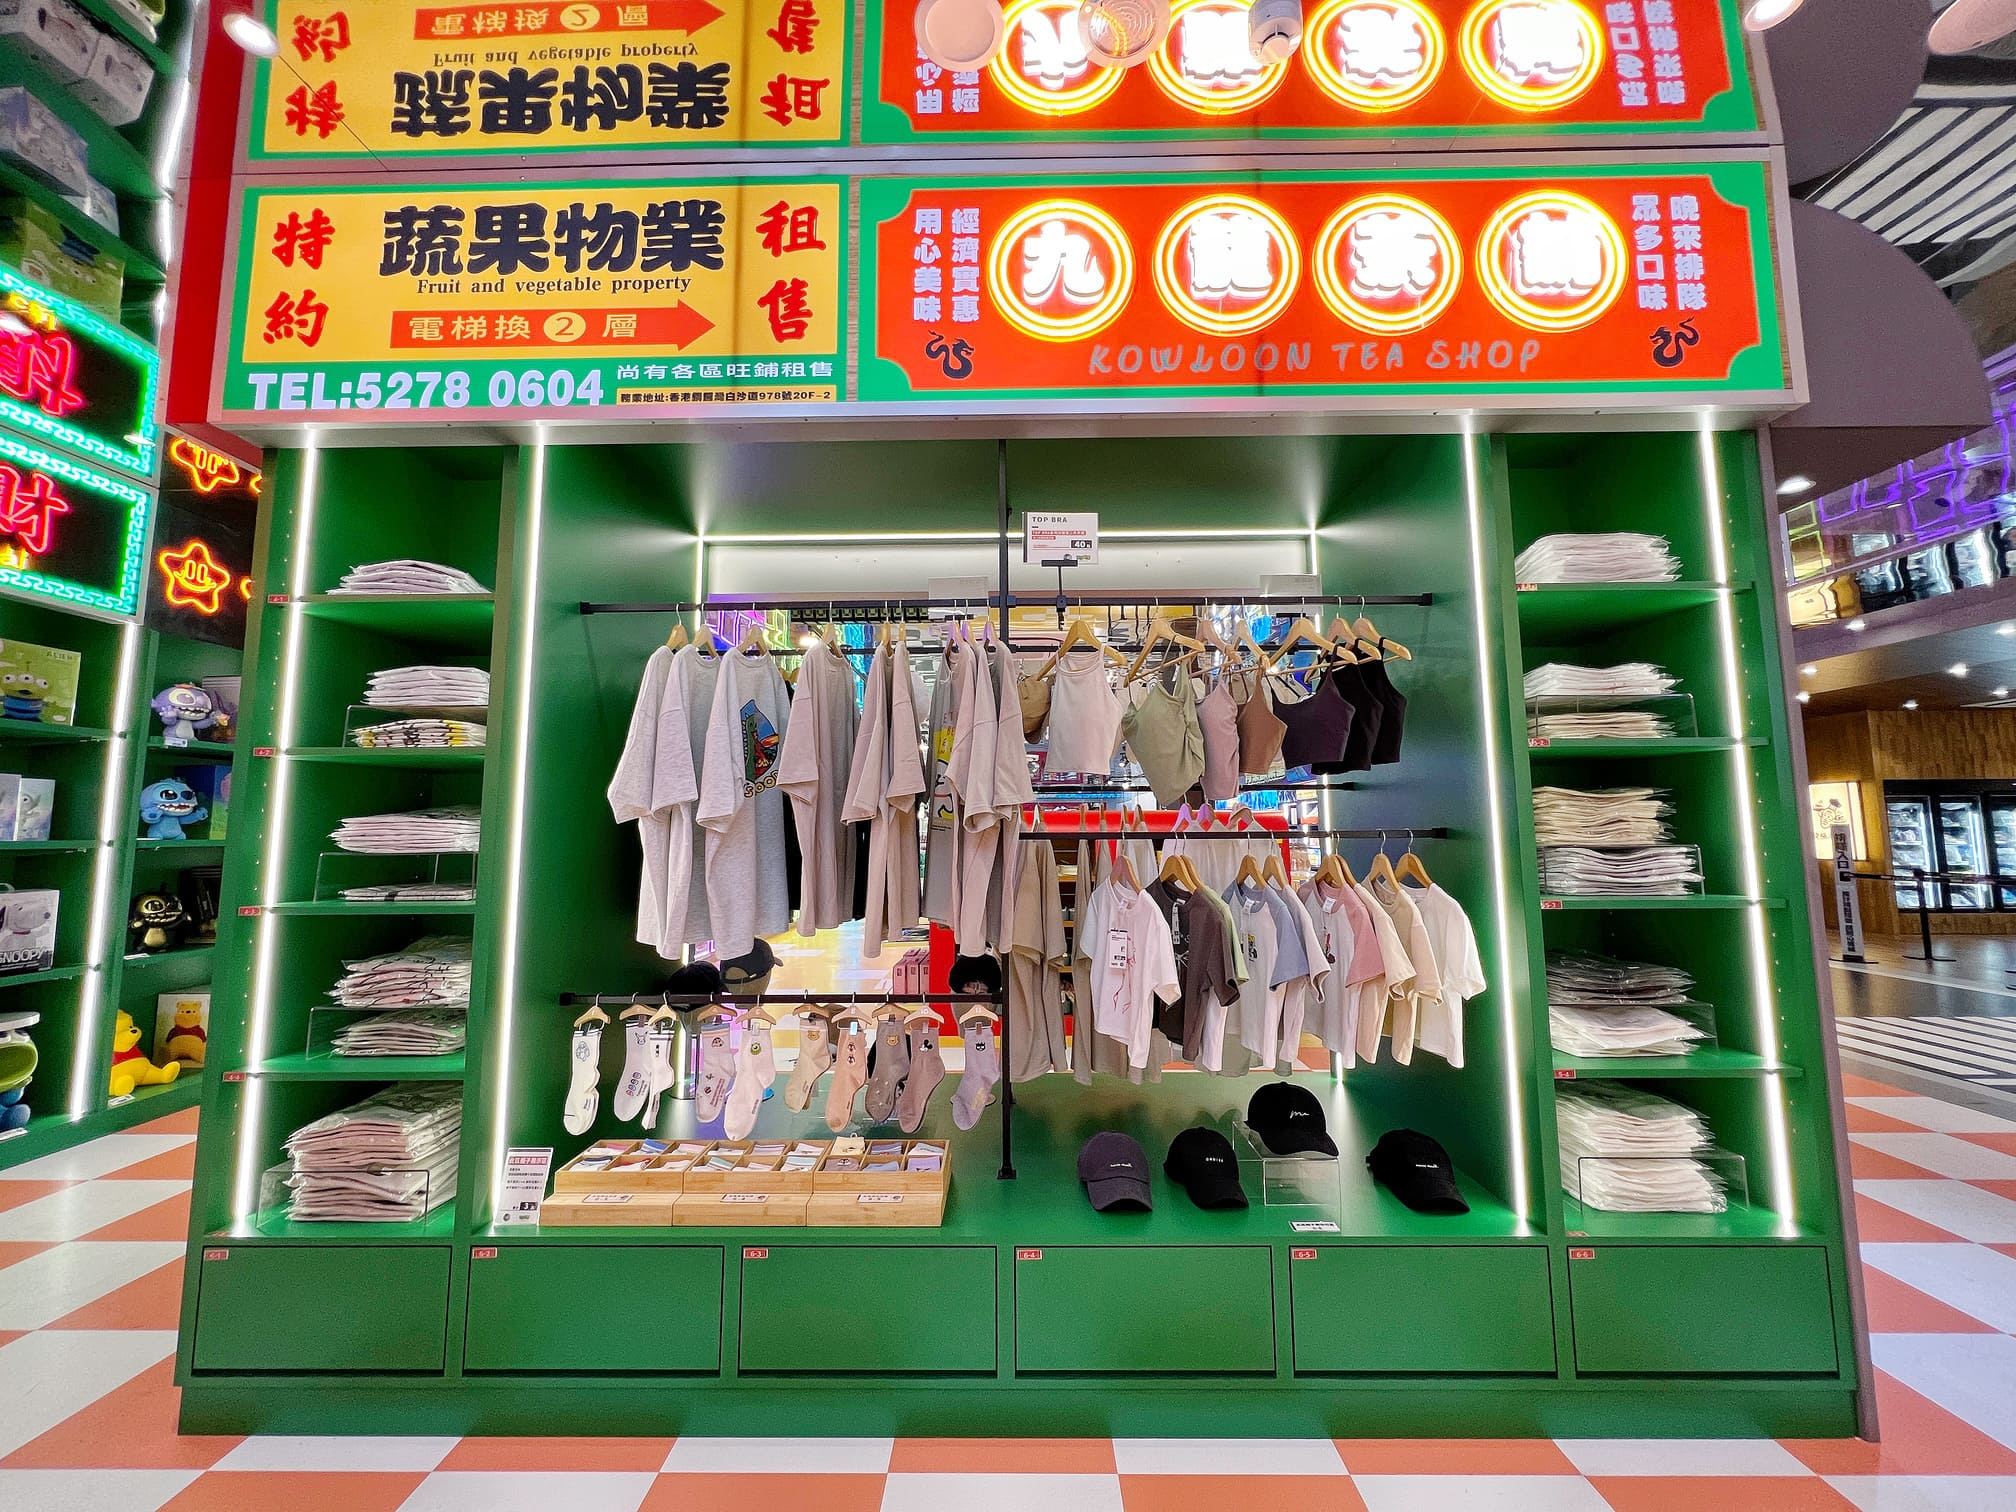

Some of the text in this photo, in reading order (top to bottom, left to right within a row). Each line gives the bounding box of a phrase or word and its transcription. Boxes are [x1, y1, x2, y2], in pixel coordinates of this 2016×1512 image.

[264, 207, 335, 348] 特約
[380, 199, 726, 277] 蔬果物業
[417, 275, 692, 294] Fruit and vegetable property
[756, 200, 827, 344] 租售
[913, 207, 943, 323] 用心美味
[951, 207, 980, 323] 經濟實惠
[1632, 194, 1669, 311] 眾多口味
[1670, 193, 1708, 311] 晚來排隊
[248, 369, 605, 410] TEL:5278 0604
[617, 361, 833, 381] 尚有各區旺鋪租售
[1089, 340, 1541, 375] KOWLOON TEA SHOP
